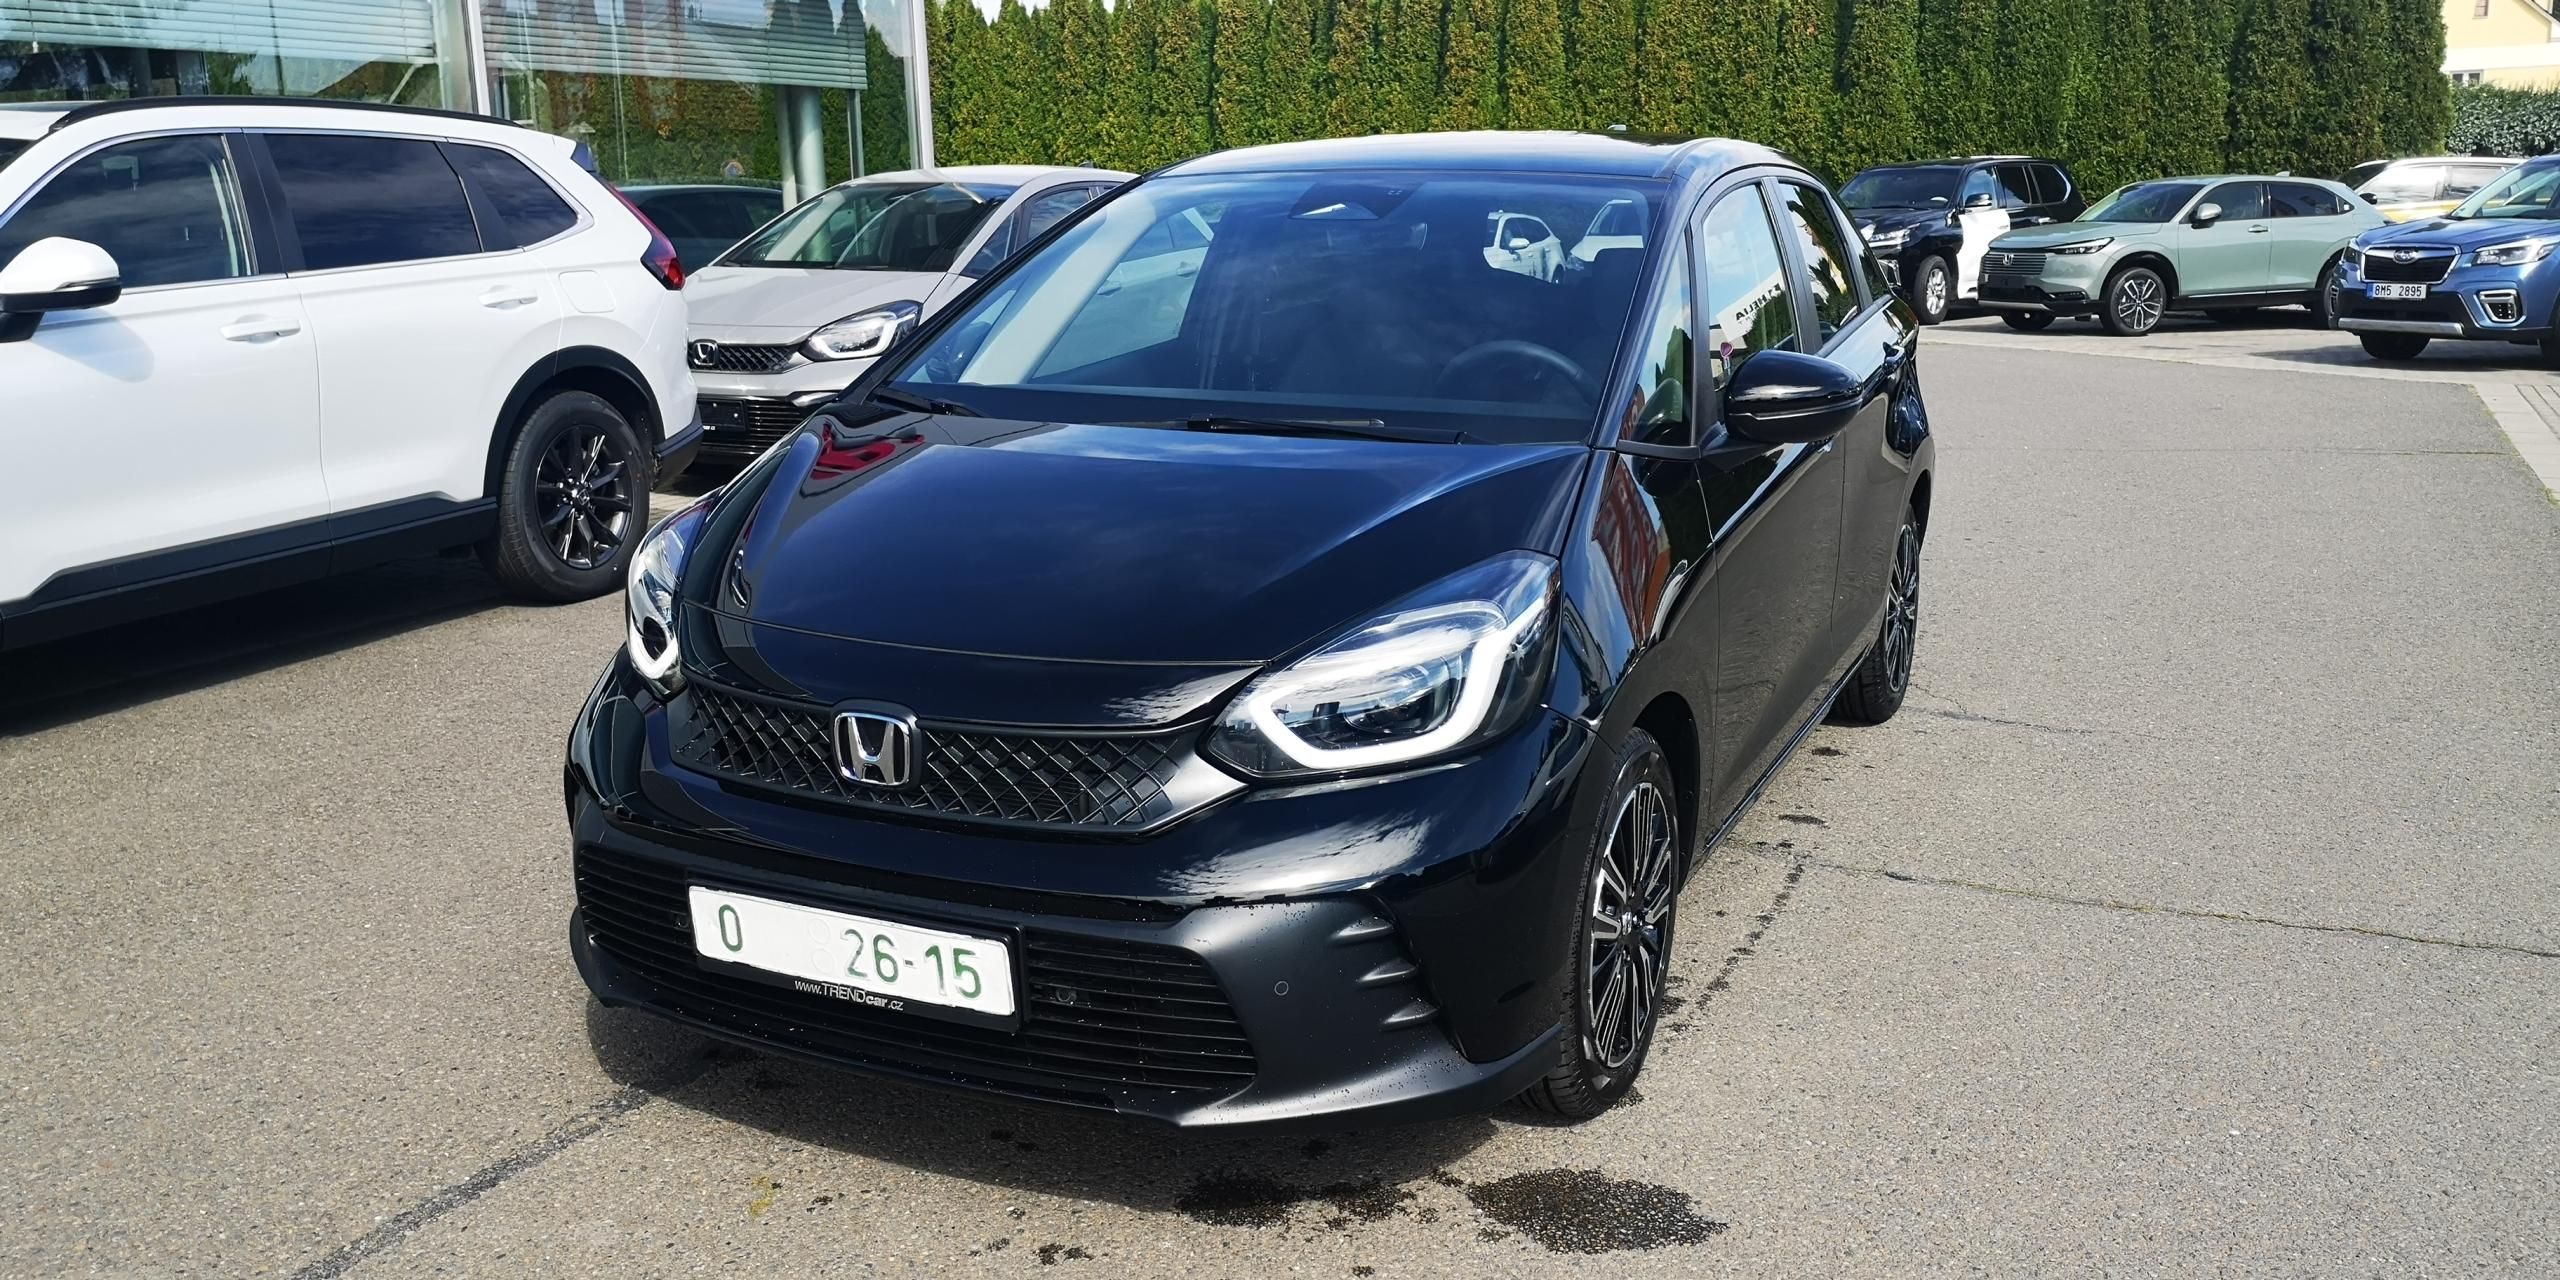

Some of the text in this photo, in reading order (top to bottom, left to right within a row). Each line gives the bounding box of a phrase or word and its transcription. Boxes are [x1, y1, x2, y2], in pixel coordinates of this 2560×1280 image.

[2375, 284, 2392, 296] 8M5
[2399, 285, 2422, 297] 2895
[843, 929, 982, 999] 26-15
